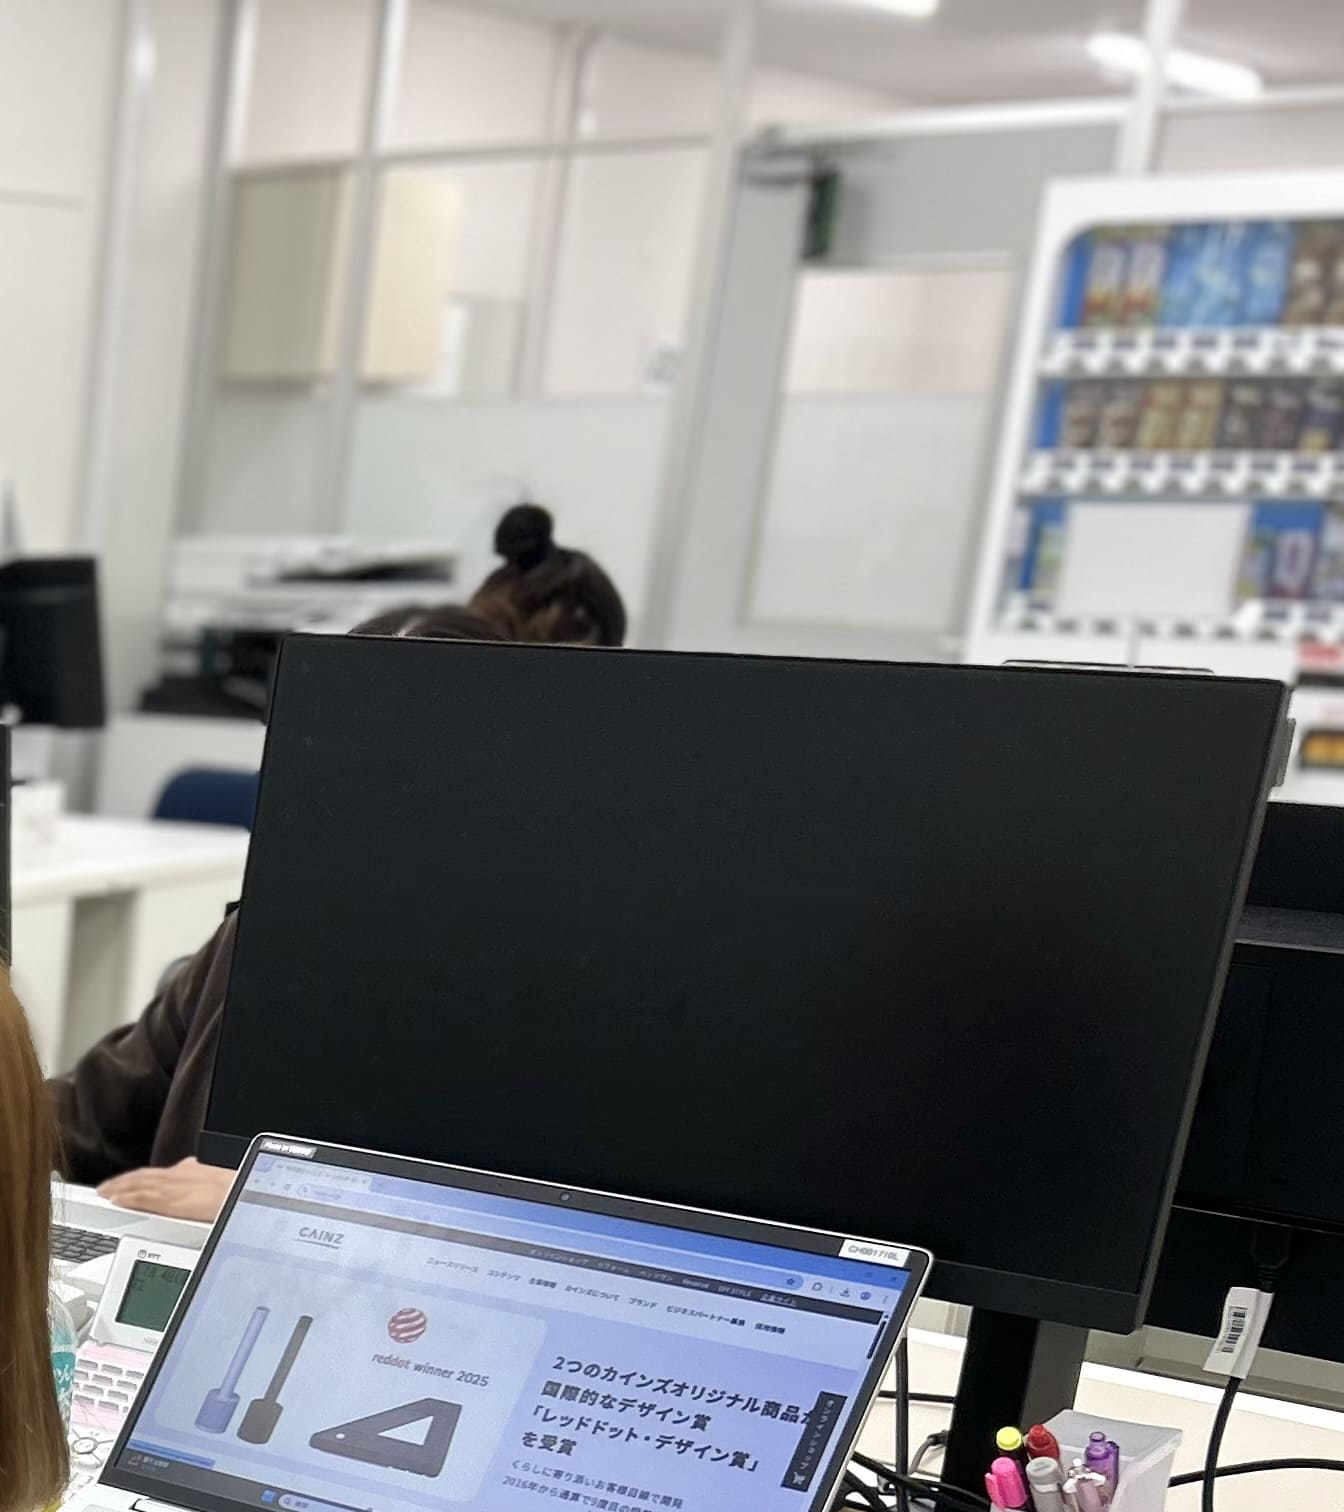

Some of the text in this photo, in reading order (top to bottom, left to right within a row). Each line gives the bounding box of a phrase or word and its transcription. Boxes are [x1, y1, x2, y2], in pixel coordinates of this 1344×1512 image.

[298, 1226, 345, 1245] CAINZ
[413, 1362, 454, 1379] winner
[456, 1370, 489, 1387] 2025
[541, 1380, 712, 1432] 国際的なデザイン賞
[521, 1431, 577, 1457] を受賞
[532, 1404, 759, 1472] 「レッドドット・デザイン賞」
[512, 1459, 683, 1509] くらしに寄り添いお客様目線で開発
